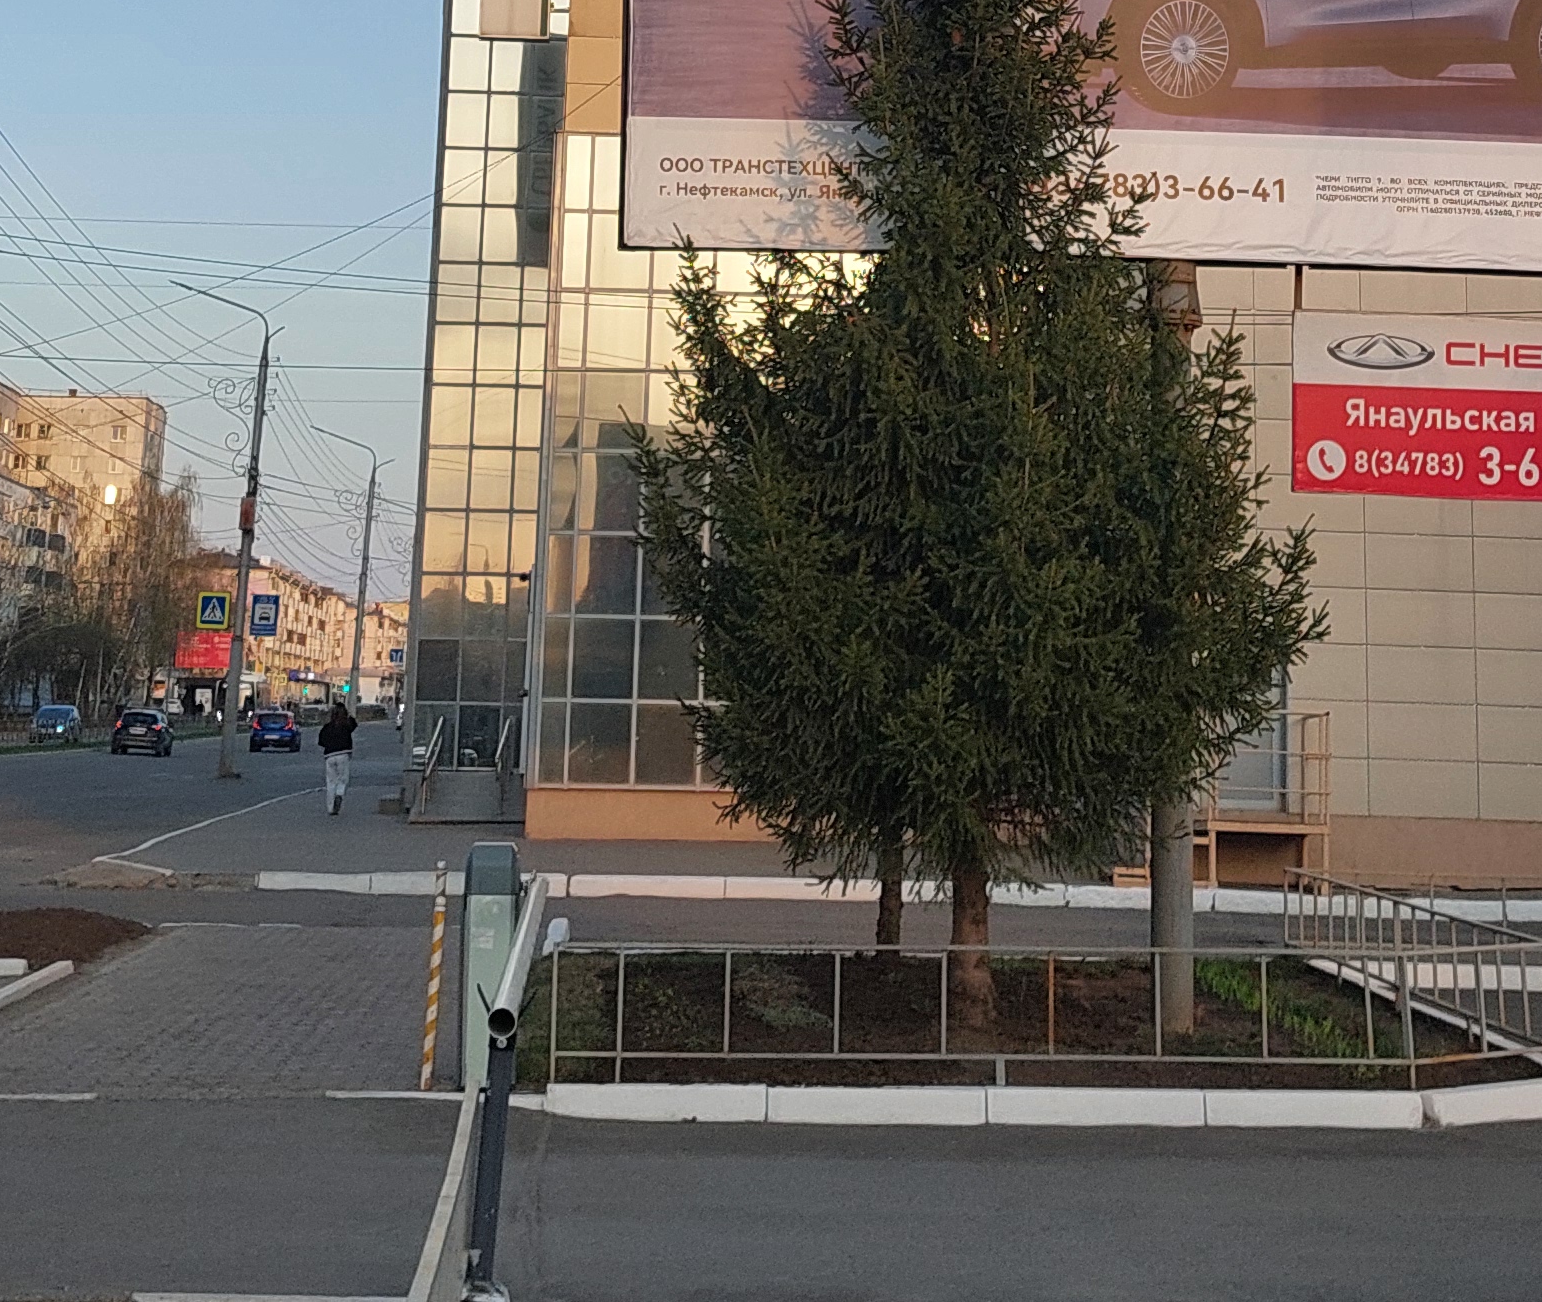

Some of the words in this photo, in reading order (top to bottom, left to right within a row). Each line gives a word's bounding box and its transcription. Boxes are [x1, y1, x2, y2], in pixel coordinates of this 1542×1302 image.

[659, 157, 704, 174] ООО
[659, 185, 671, 197] г.
[676, 182, 784, 201] Нефтекамск,
[787, 186, 812, 200] ул.
[1316, 184, 1373, 193] АВТОМОБИЛИ
[1376, 186, 1403, 195] МОГУТ
[1406, 187, 1460, 196] ОТЛИЧАТЬСЯ
[1316, 193, 1379, 203] ПОДРОБНОСТИ
[1345, 398, 1536, 436] Янаульская
[1354, 449, 1465, 481] 8(34783)
